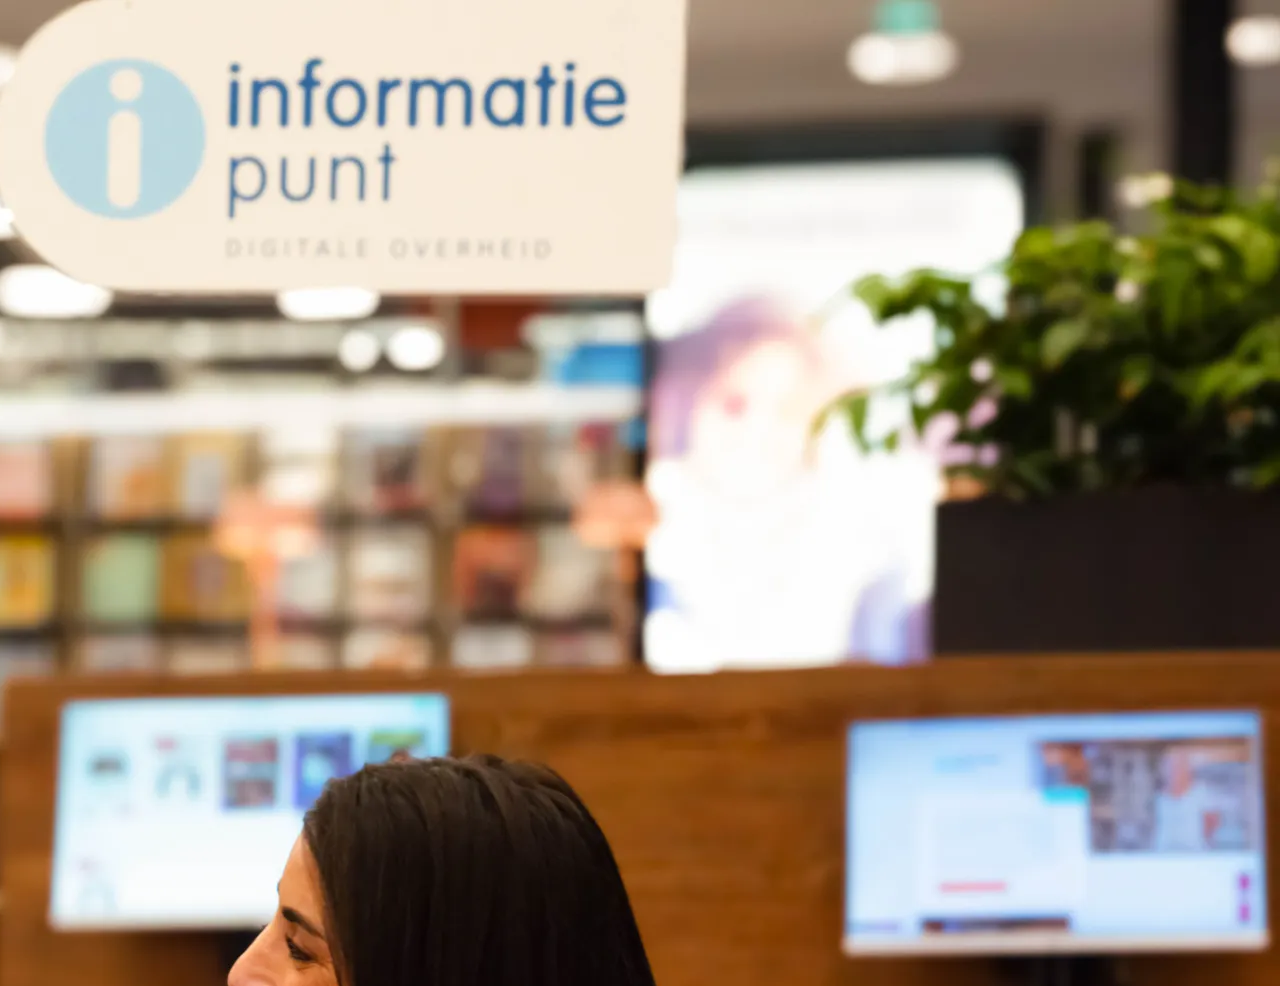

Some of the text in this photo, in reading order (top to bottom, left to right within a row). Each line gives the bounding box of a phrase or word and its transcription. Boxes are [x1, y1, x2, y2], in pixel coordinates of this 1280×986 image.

[227, 58, 627, 128] informatie
[227, 144, 396, 218] punt
[224, 237, 554, 260] DIGITALE OVERHEID
